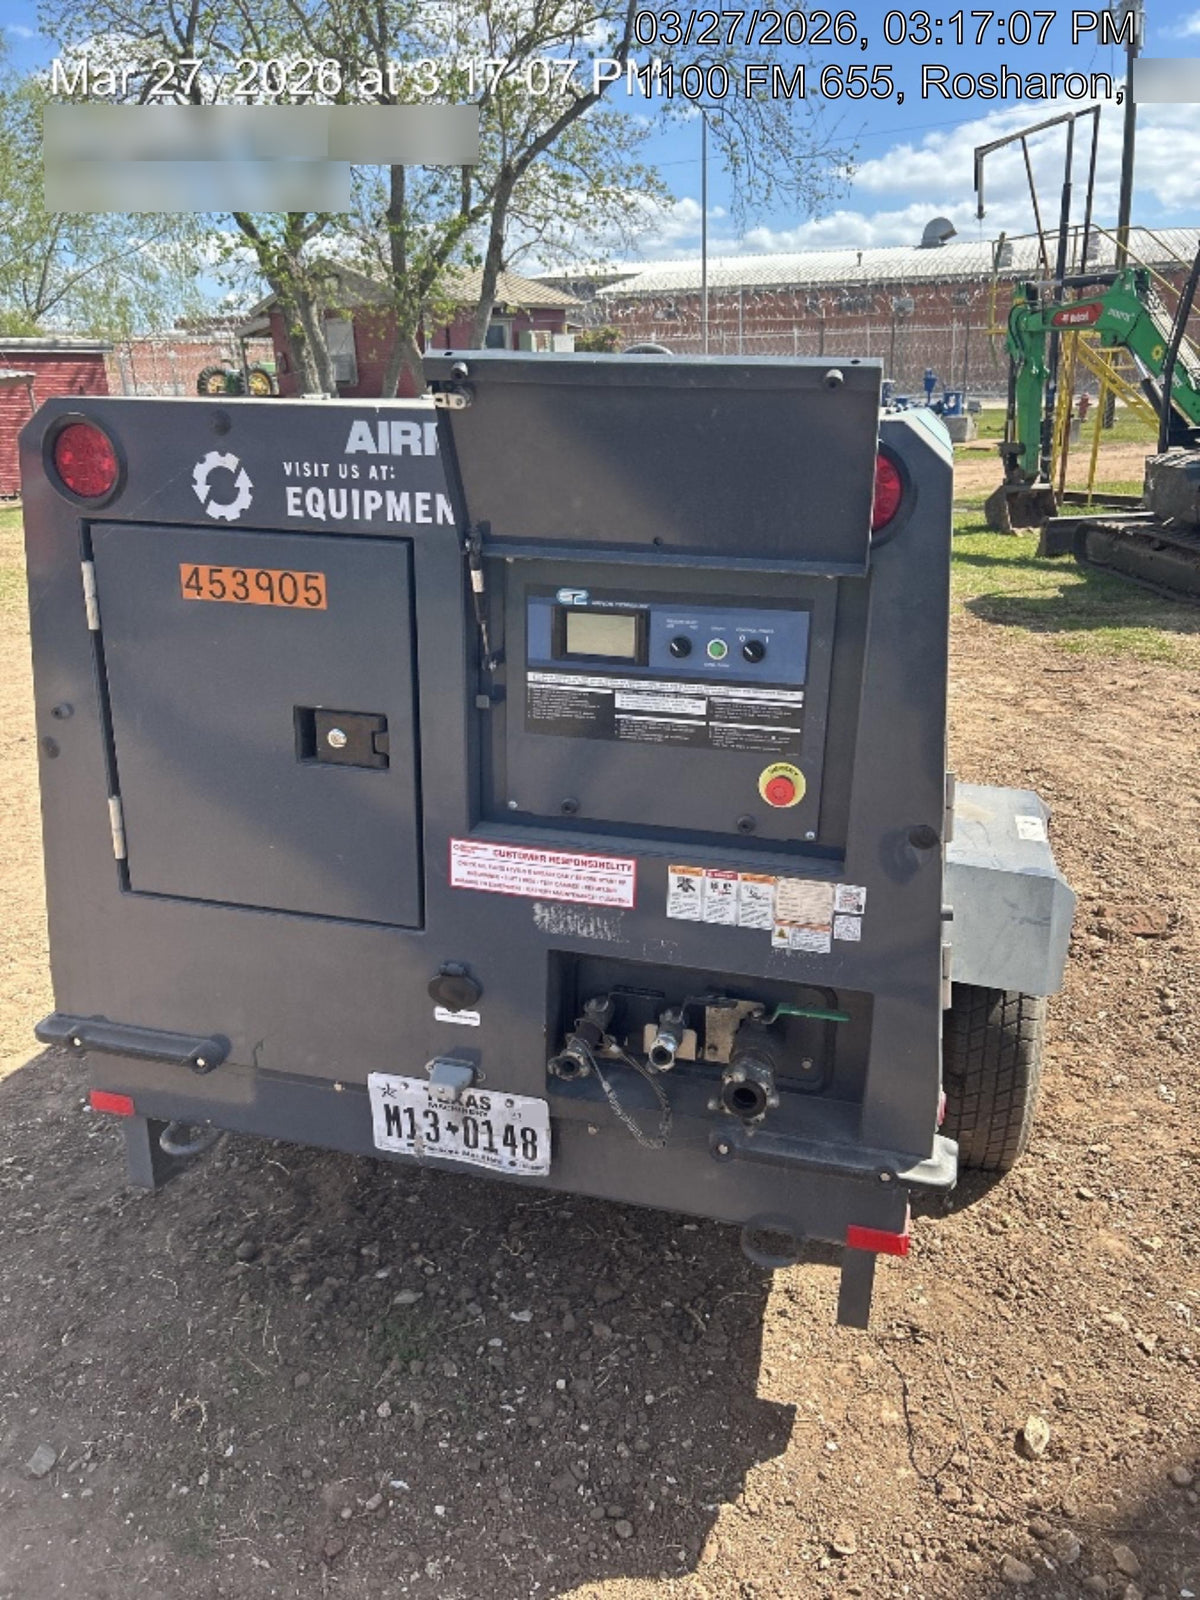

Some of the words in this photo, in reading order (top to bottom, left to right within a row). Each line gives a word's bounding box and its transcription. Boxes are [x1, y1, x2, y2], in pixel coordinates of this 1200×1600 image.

[283, 461, 329, 478] VISIT
[338, 464, 360, 480] US
[368, 465, 396, 481] AT:
[286, 486, 455, 525] EQUIPMEN
[184, 566, 323, 607] 453905
[492, 848, 548, 864] CUSTOMER
[548, 855, 632, 872] RESPONSIBILITY
